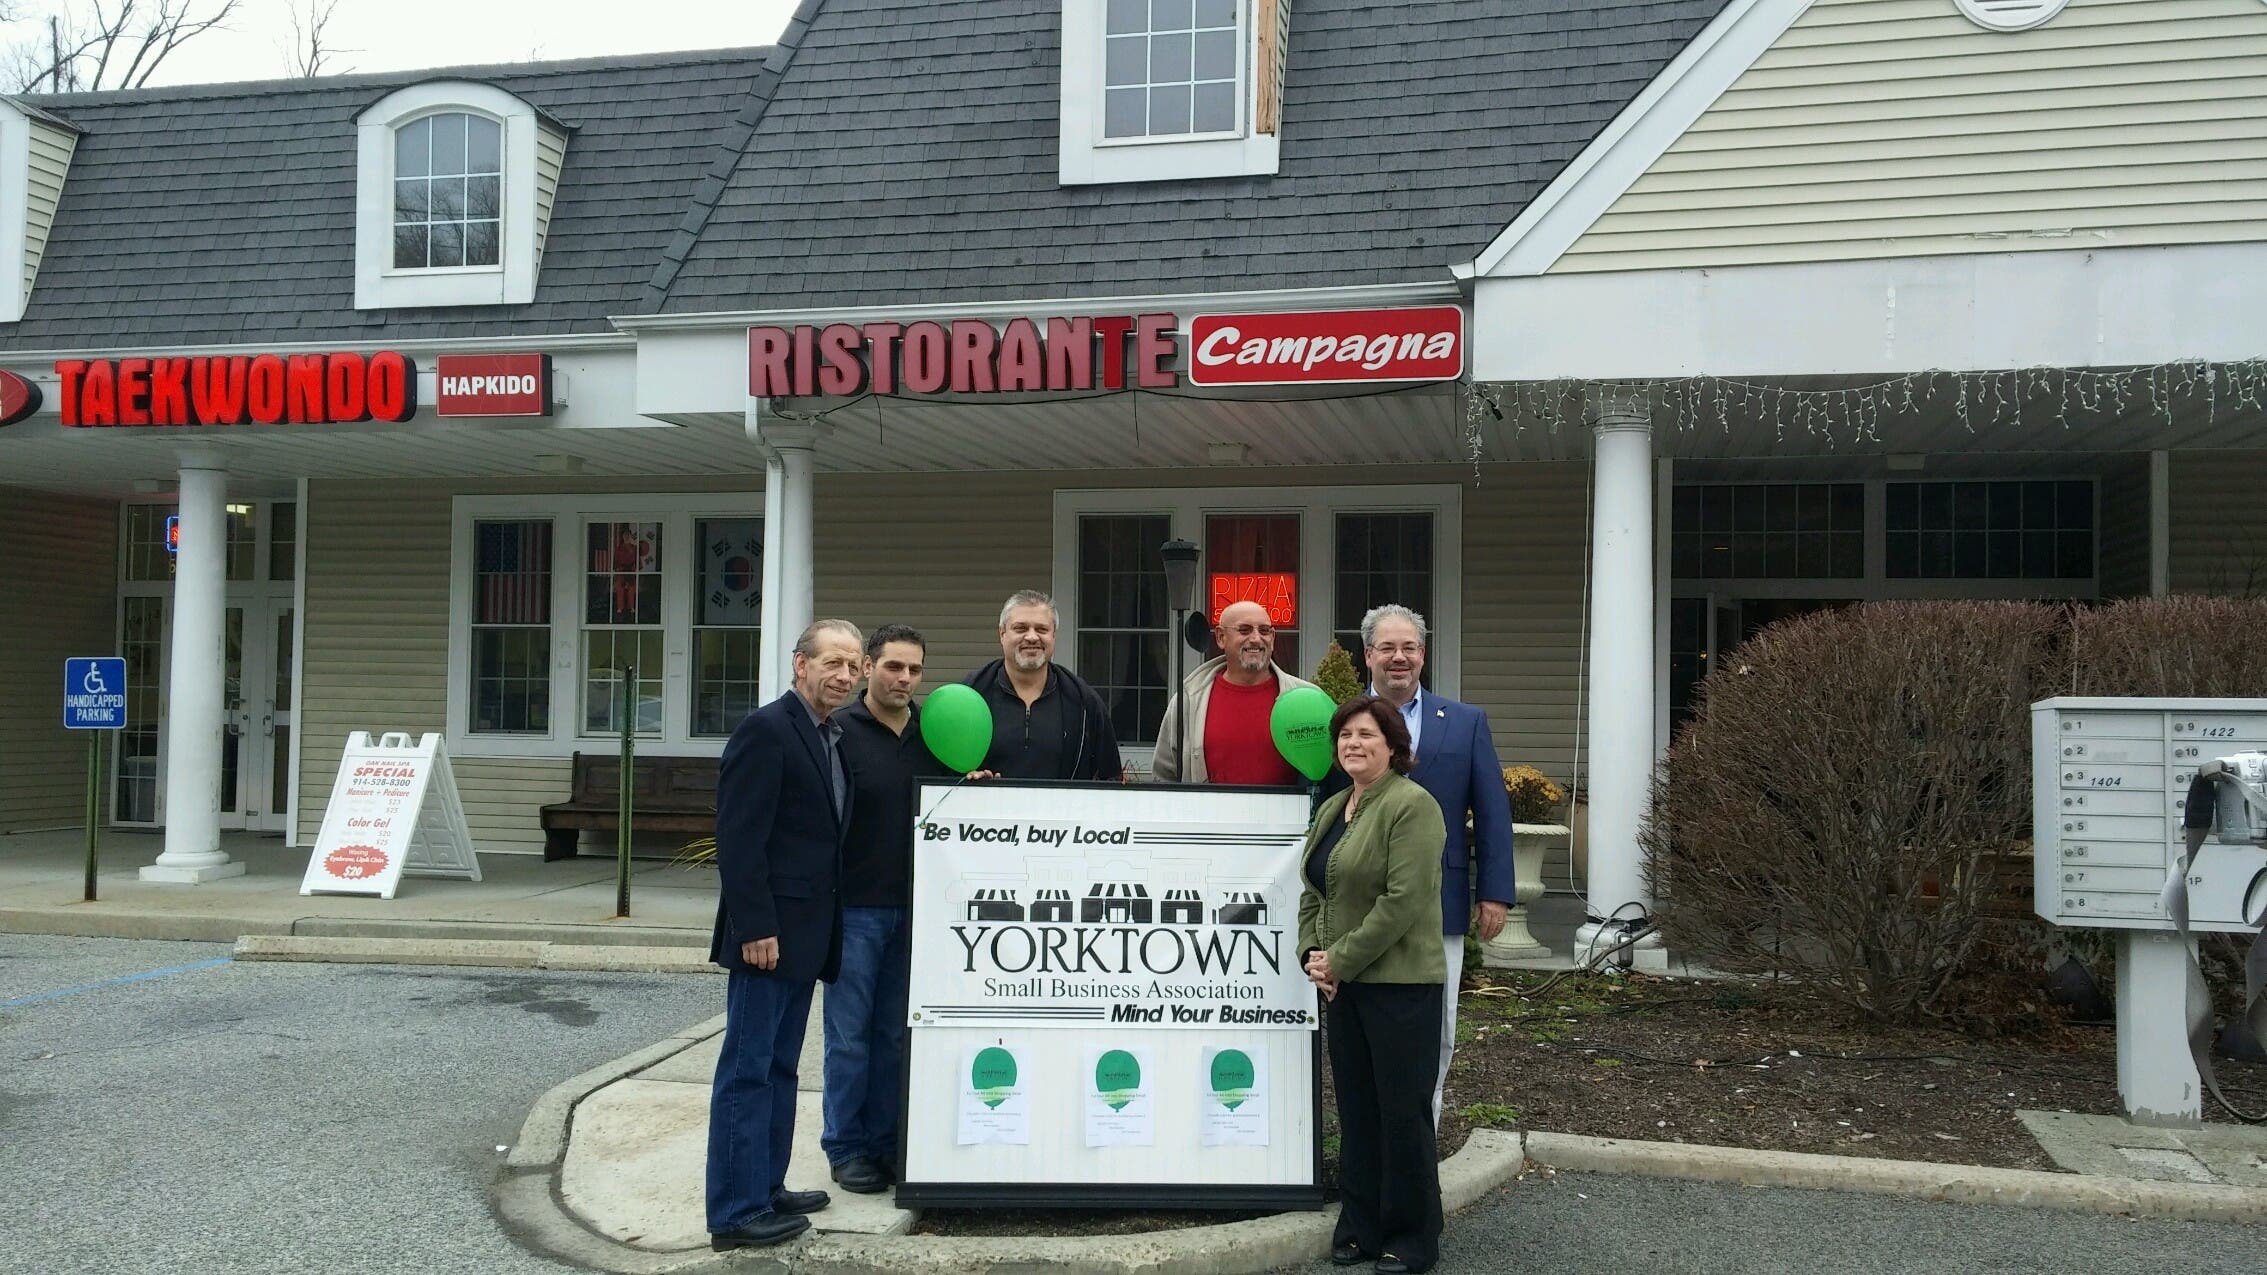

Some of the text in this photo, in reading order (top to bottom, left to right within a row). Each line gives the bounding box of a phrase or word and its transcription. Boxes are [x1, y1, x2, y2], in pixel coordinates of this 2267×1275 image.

[1196, 326, 1456, 372] Campagna
[749, 312, 1180, 398] RISTORANTE
[55, 351, 412, 427] TAEKWONDO
[442, 375, 537, 396] HAPKIDO
[1213, 575, 1292, 609] PIZZA
[67, 694, 124, 708] HANDICAPPED
[76, 708, 115, 722] PARKING
[2076, 721, 2082, 729] 1
[2187, 722, 2195, 731] 9
[2201, 728, 2236, 737] 1422
[2076, 746, 2084, 755] 2
[2185, 748, 2199, 757] 10
[353, 767, 416, 778] SPECIAL
[2077, 771, 2084, 780] 3
[352, 778, 411, 787] 914-528-8300
[2090, 777, 2122, 787] 1404
[383, 788, 410, 797] Pedicure
[2077, 797, 2084, 805] 4
[347, 816, 391, 828] Color Gel
[2077, 822, 2084, 831] 5
[923, 822, 1131, 847] Be Vocal, buy Local
[2077, 847, 2084, 856] 6
[343, 865, 363, 877] $20
[2077, 872, 2085, 881] 7
[2188, 876, 2203, 886] 1P
[2078, 898, 2086, 907] 8
[950, 925, 1284, 976] YORKTOWN
[984, 977, 1265, 999] Small Business Association
[1111, 1004, 1164, 1023] Mind
[1170, 1005, 1213, 1024] Your
